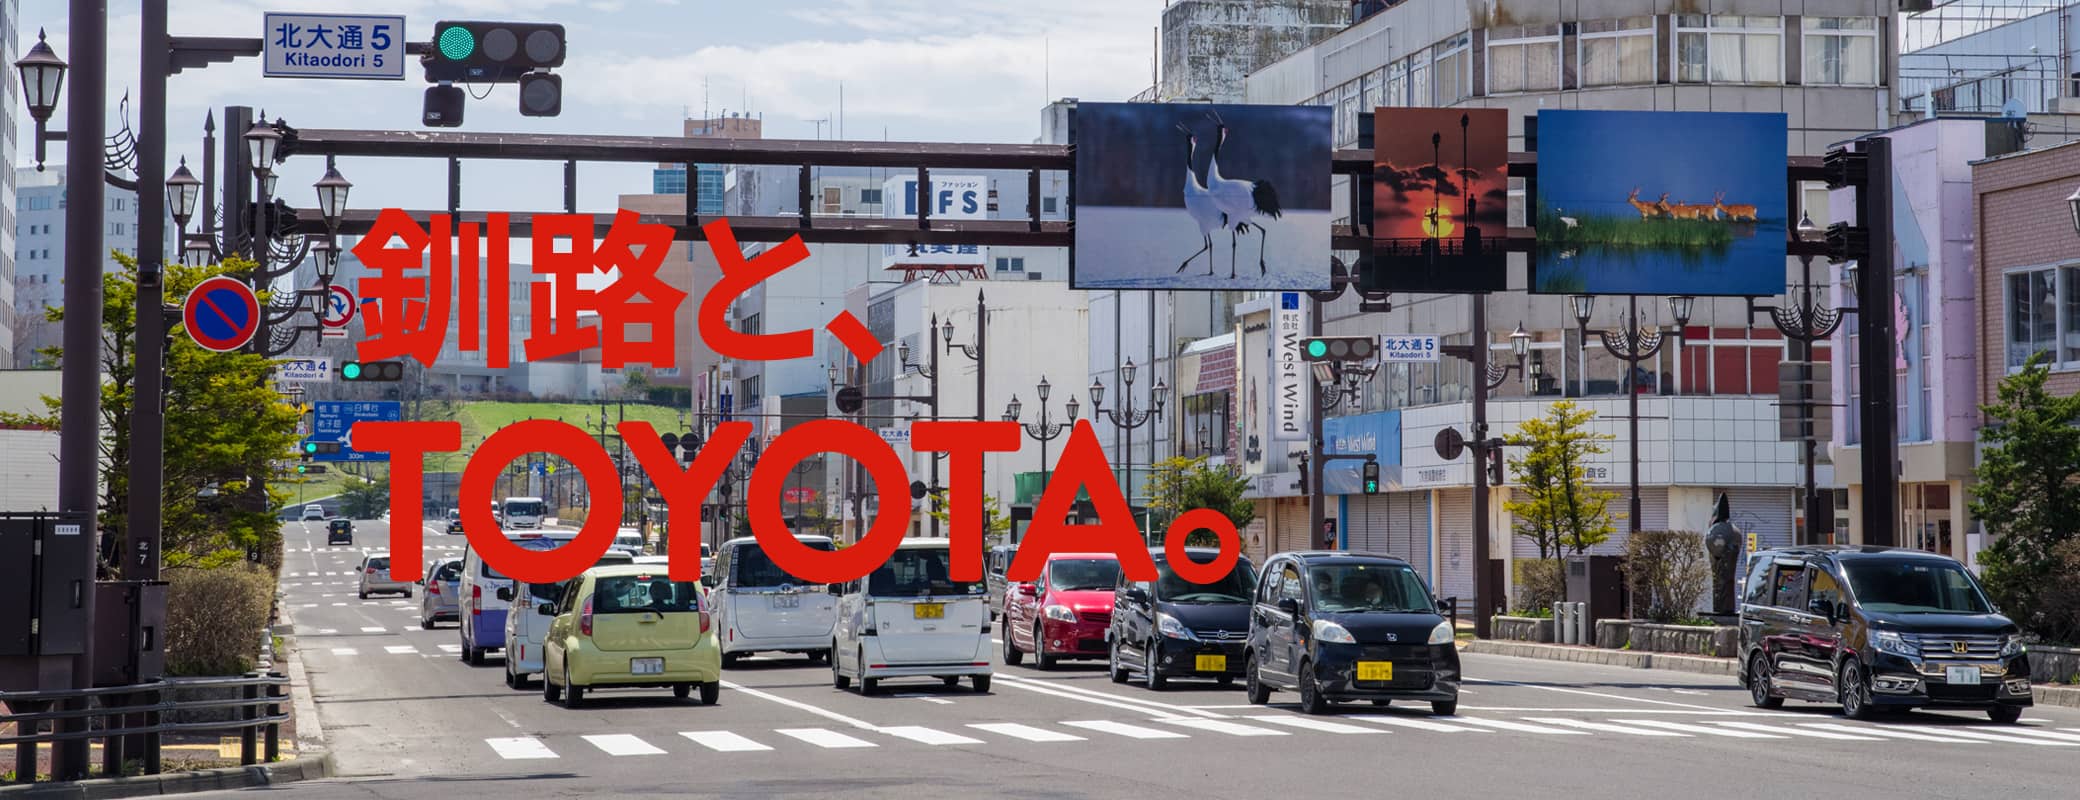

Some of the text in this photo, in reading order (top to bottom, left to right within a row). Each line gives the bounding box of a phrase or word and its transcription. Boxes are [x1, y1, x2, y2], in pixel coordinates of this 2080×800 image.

[275, 22, 391, 50] 北大通5
[285, 52, 384, 67] Kitaodori 5
[1385, 338, 1434, 350] 北大通5
[1283, 332, 1299, 433] West Wind
